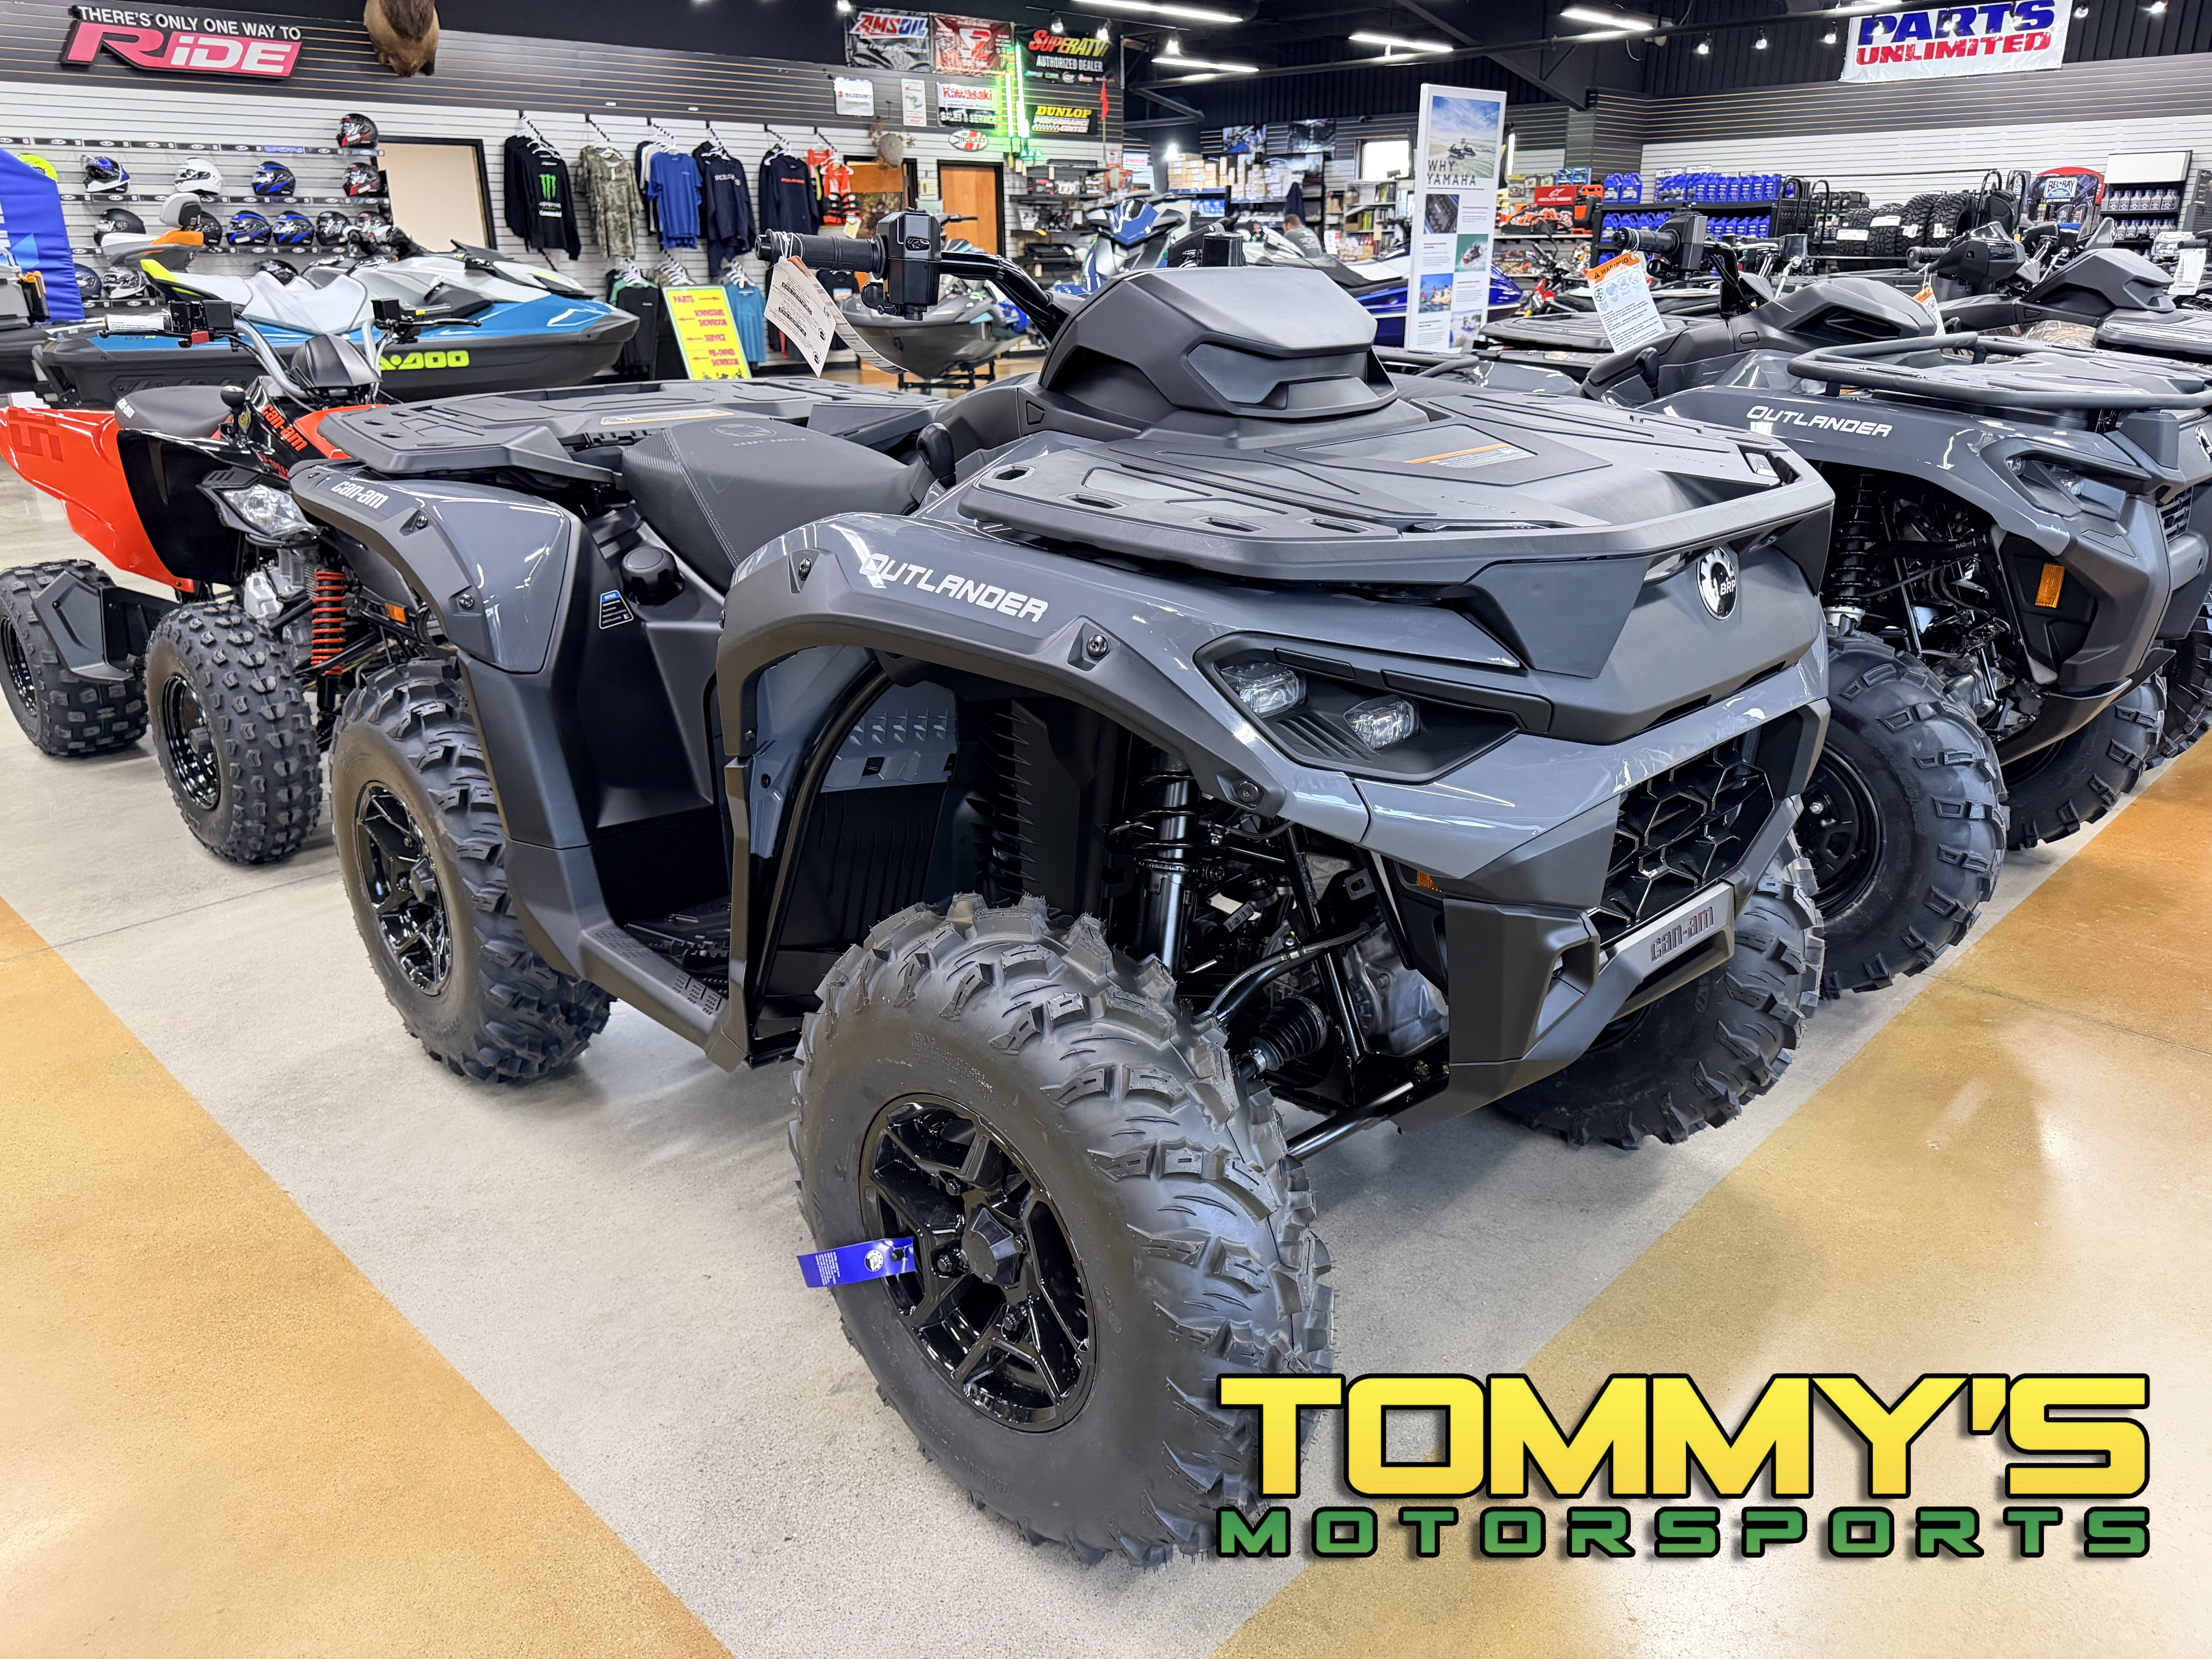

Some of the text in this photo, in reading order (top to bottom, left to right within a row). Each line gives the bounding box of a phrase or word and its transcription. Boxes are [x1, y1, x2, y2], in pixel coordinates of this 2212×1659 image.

[78, 6, 302, 41] THERE'S ONLY ONE WAY TO
[855, 14, 926, 37] AMSOIL
[1857, 0, 2056, 45] PARTS
[1856, 31, 2052, 65] UNLIMITED
[1036, 55, 1104, 72] AUTHORIZED DEALER
[1035, 105, 1092, 119] DUNLOP
[1427, 160, 1455, 172] WHY
[1427, 173, 1477, 186] YAMAHA
[1600, 258, 1629, 275] WARNING
[262, 404, 308, 452] can-am
[1746, 405, 1893, 438] OUTLANDER
[331, 480, 389, 510] can-am
[858, 553, 1049, 623] OUTLANDER
[1719, 580, 1737, 596] BRP
[1650, 905, 1714, 963] can-am
